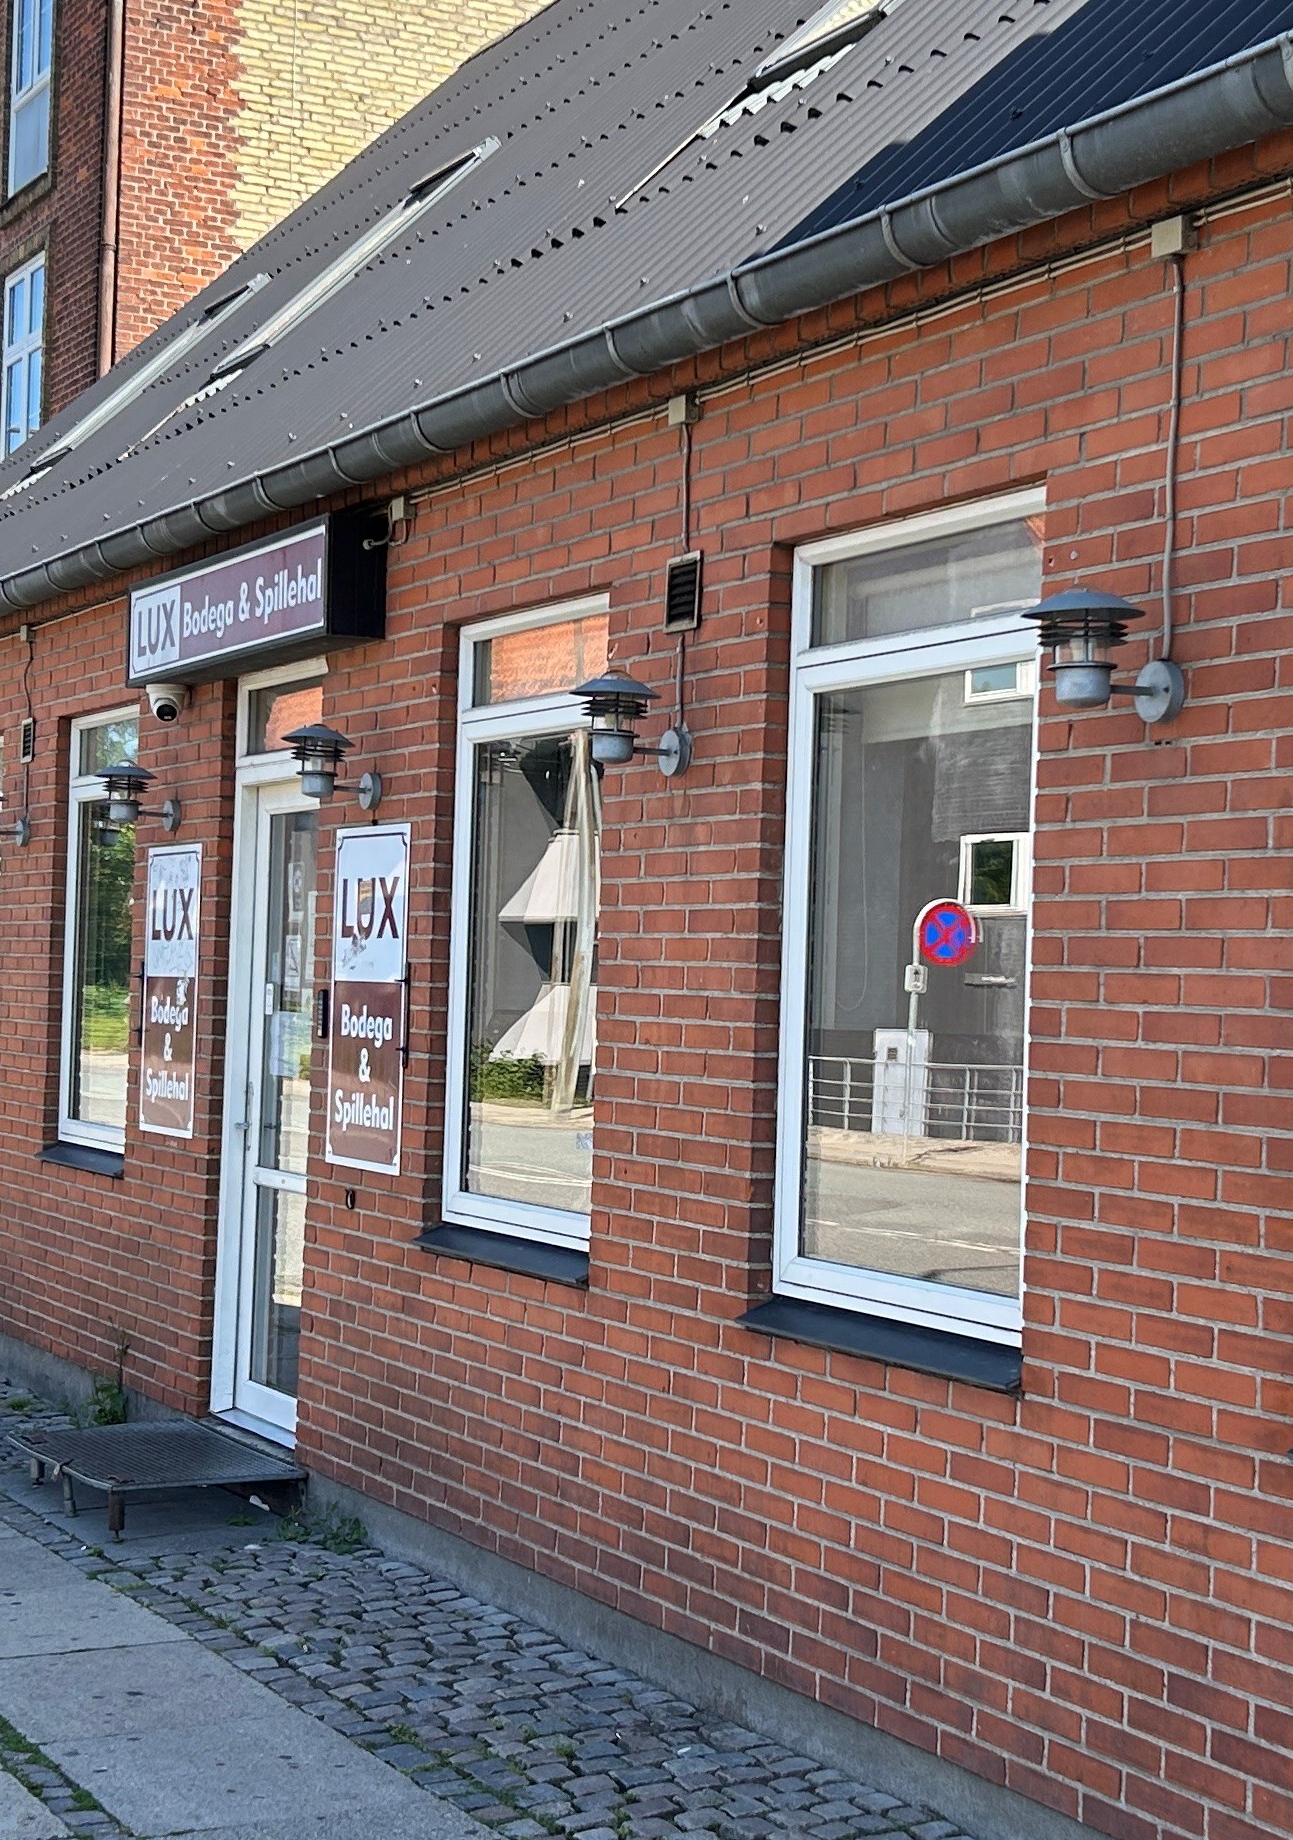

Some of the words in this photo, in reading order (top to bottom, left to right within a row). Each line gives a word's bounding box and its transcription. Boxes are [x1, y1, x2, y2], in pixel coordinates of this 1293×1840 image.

[137, 599, 176, 658] LUX
[183, 595, 234, 638] Bodega
[238, 582, 250, 620] &
[255, 558, 322, 624] Spillehal
[151, 888, 194, 942] LUX
[341, 876, 400, 940] LUX
[151, 996, 188, 1032] Bodega
[341, 1003, 393, 1048] Bodega
[163, 1032, 173, 1061] &
[359, 1048, 371, 1082] &
[146, 1068, 189, 1103] Spillehal
[334, 1089, 394, 1132] Spillehal
